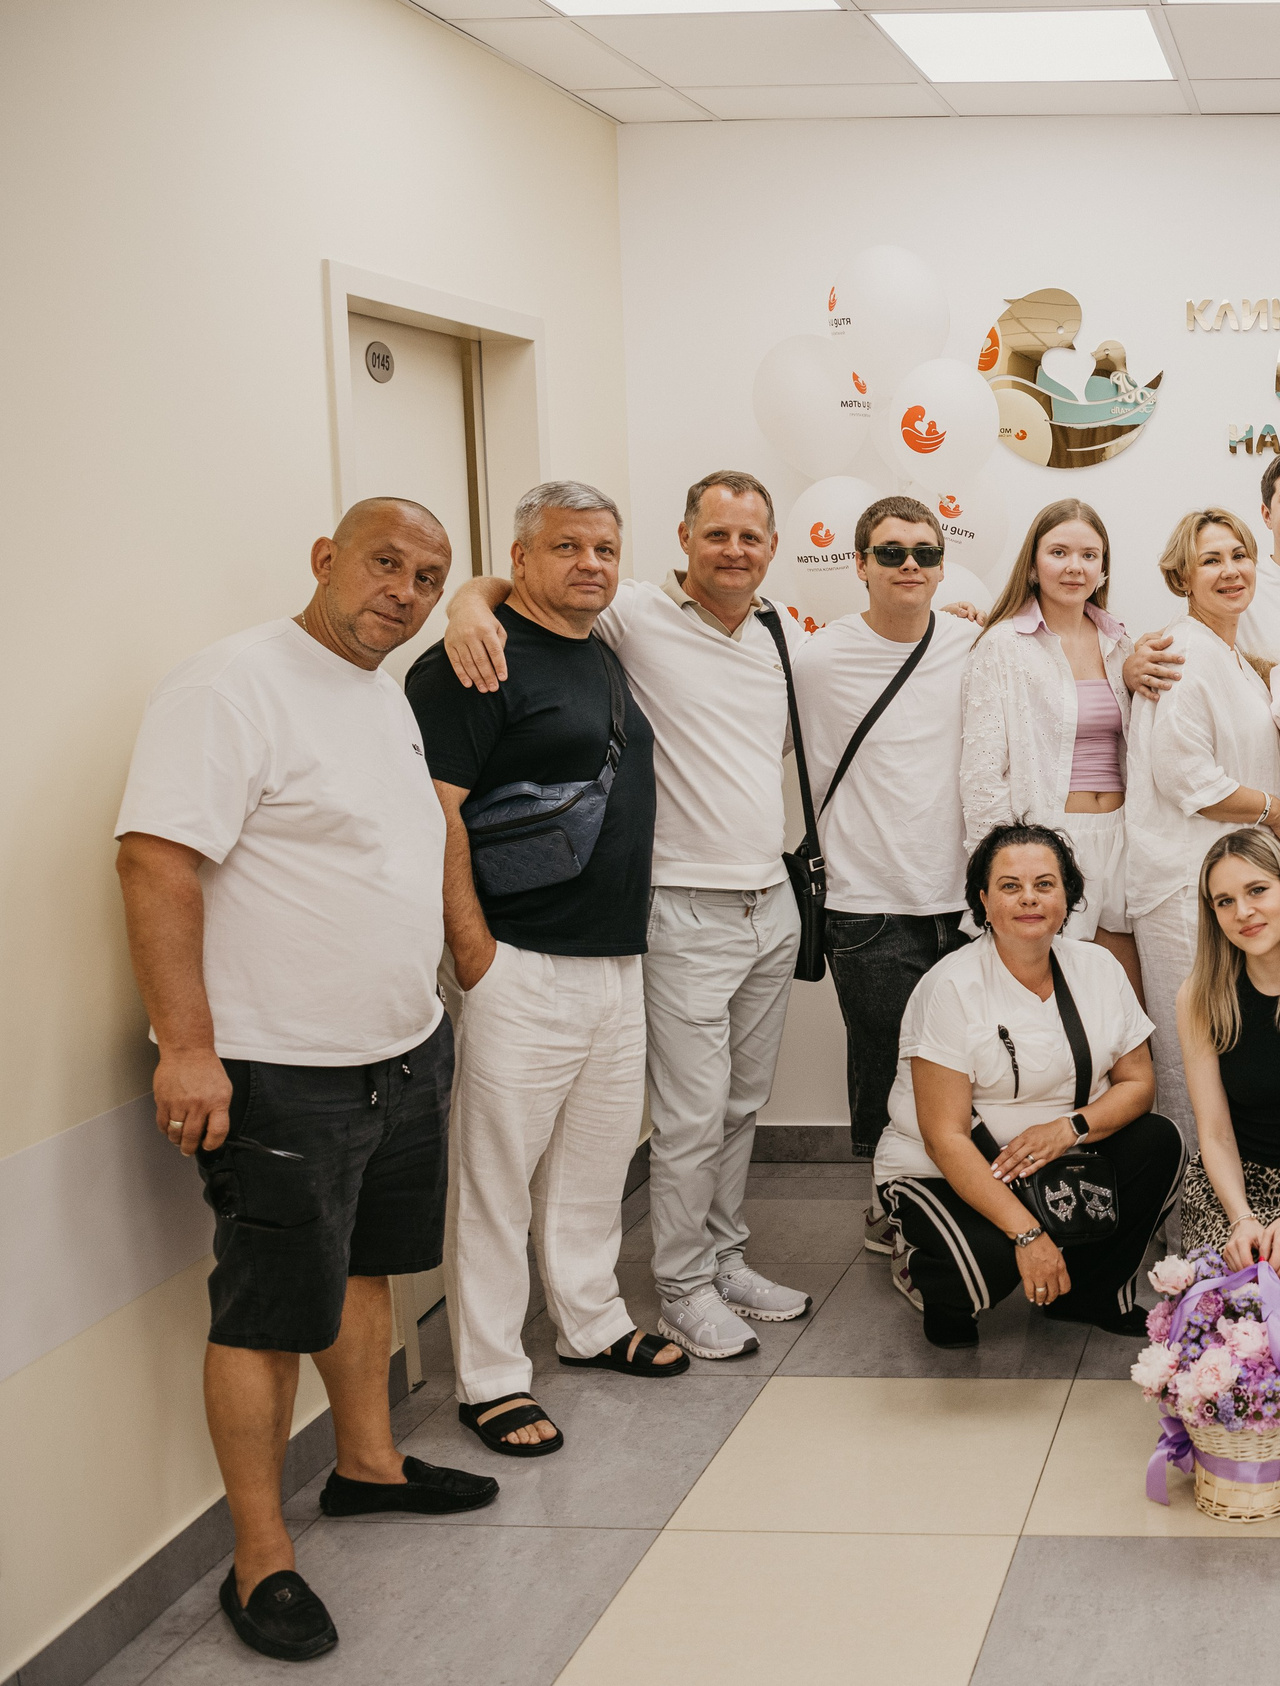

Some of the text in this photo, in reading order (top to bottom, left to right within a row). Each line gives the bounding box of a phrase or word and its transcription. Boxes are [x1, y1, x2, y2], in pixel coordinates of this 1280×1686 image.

[371, 351, 390, 371] 0145
[1229, 423, 1280, 455] НА
[941, 523, 975, 540] и дитя
[796, 555, 820, 563] мать
[821, 554, 829, 562] и
